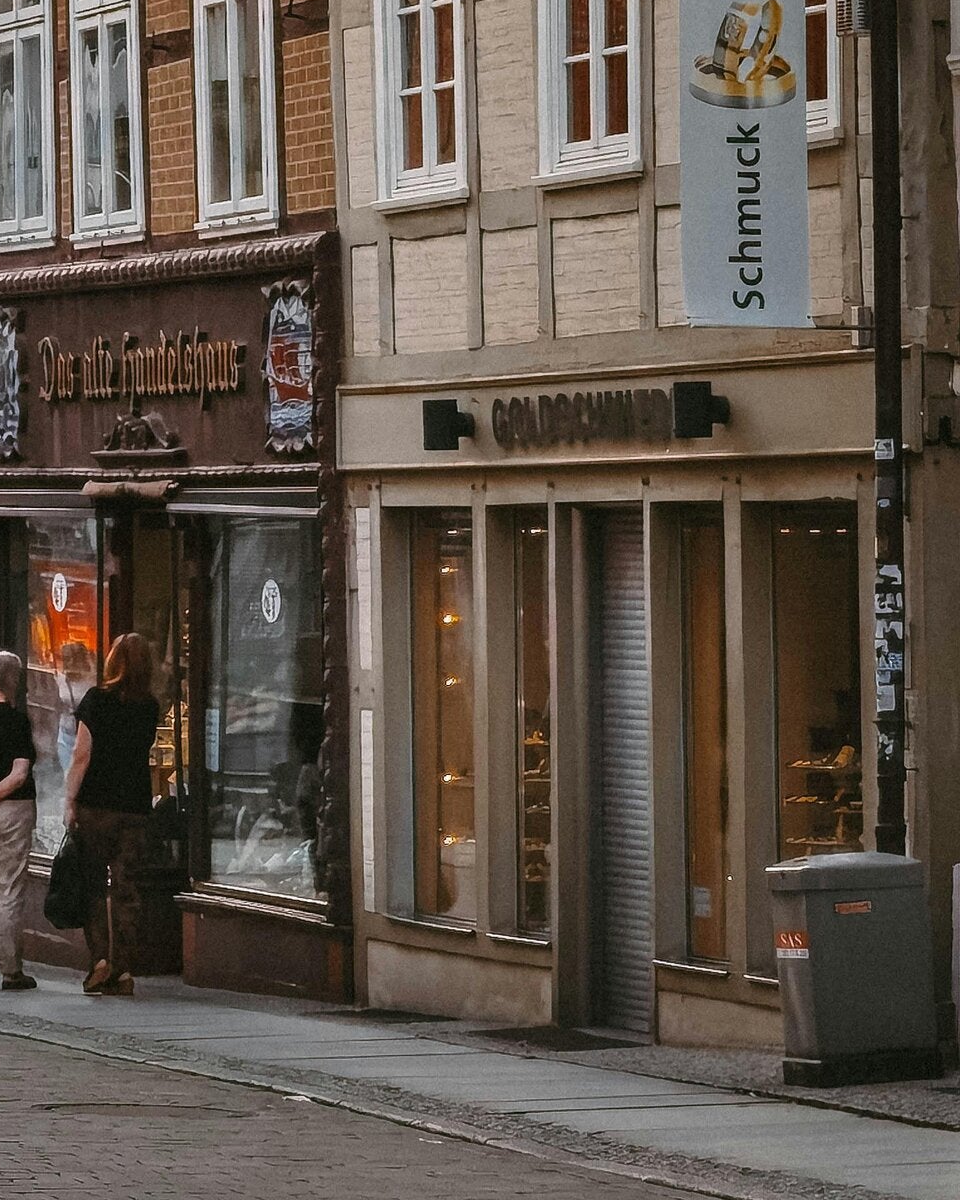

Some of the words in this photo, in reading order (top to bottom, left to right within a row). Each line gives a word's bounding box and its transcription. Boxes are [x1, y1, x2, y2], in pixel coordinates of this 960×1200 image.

[726, 122, 765, 310] Schmuck
[492, 388, 674, 448] GOLDSCHMIED
[780, 933, 803, 948] SAS
